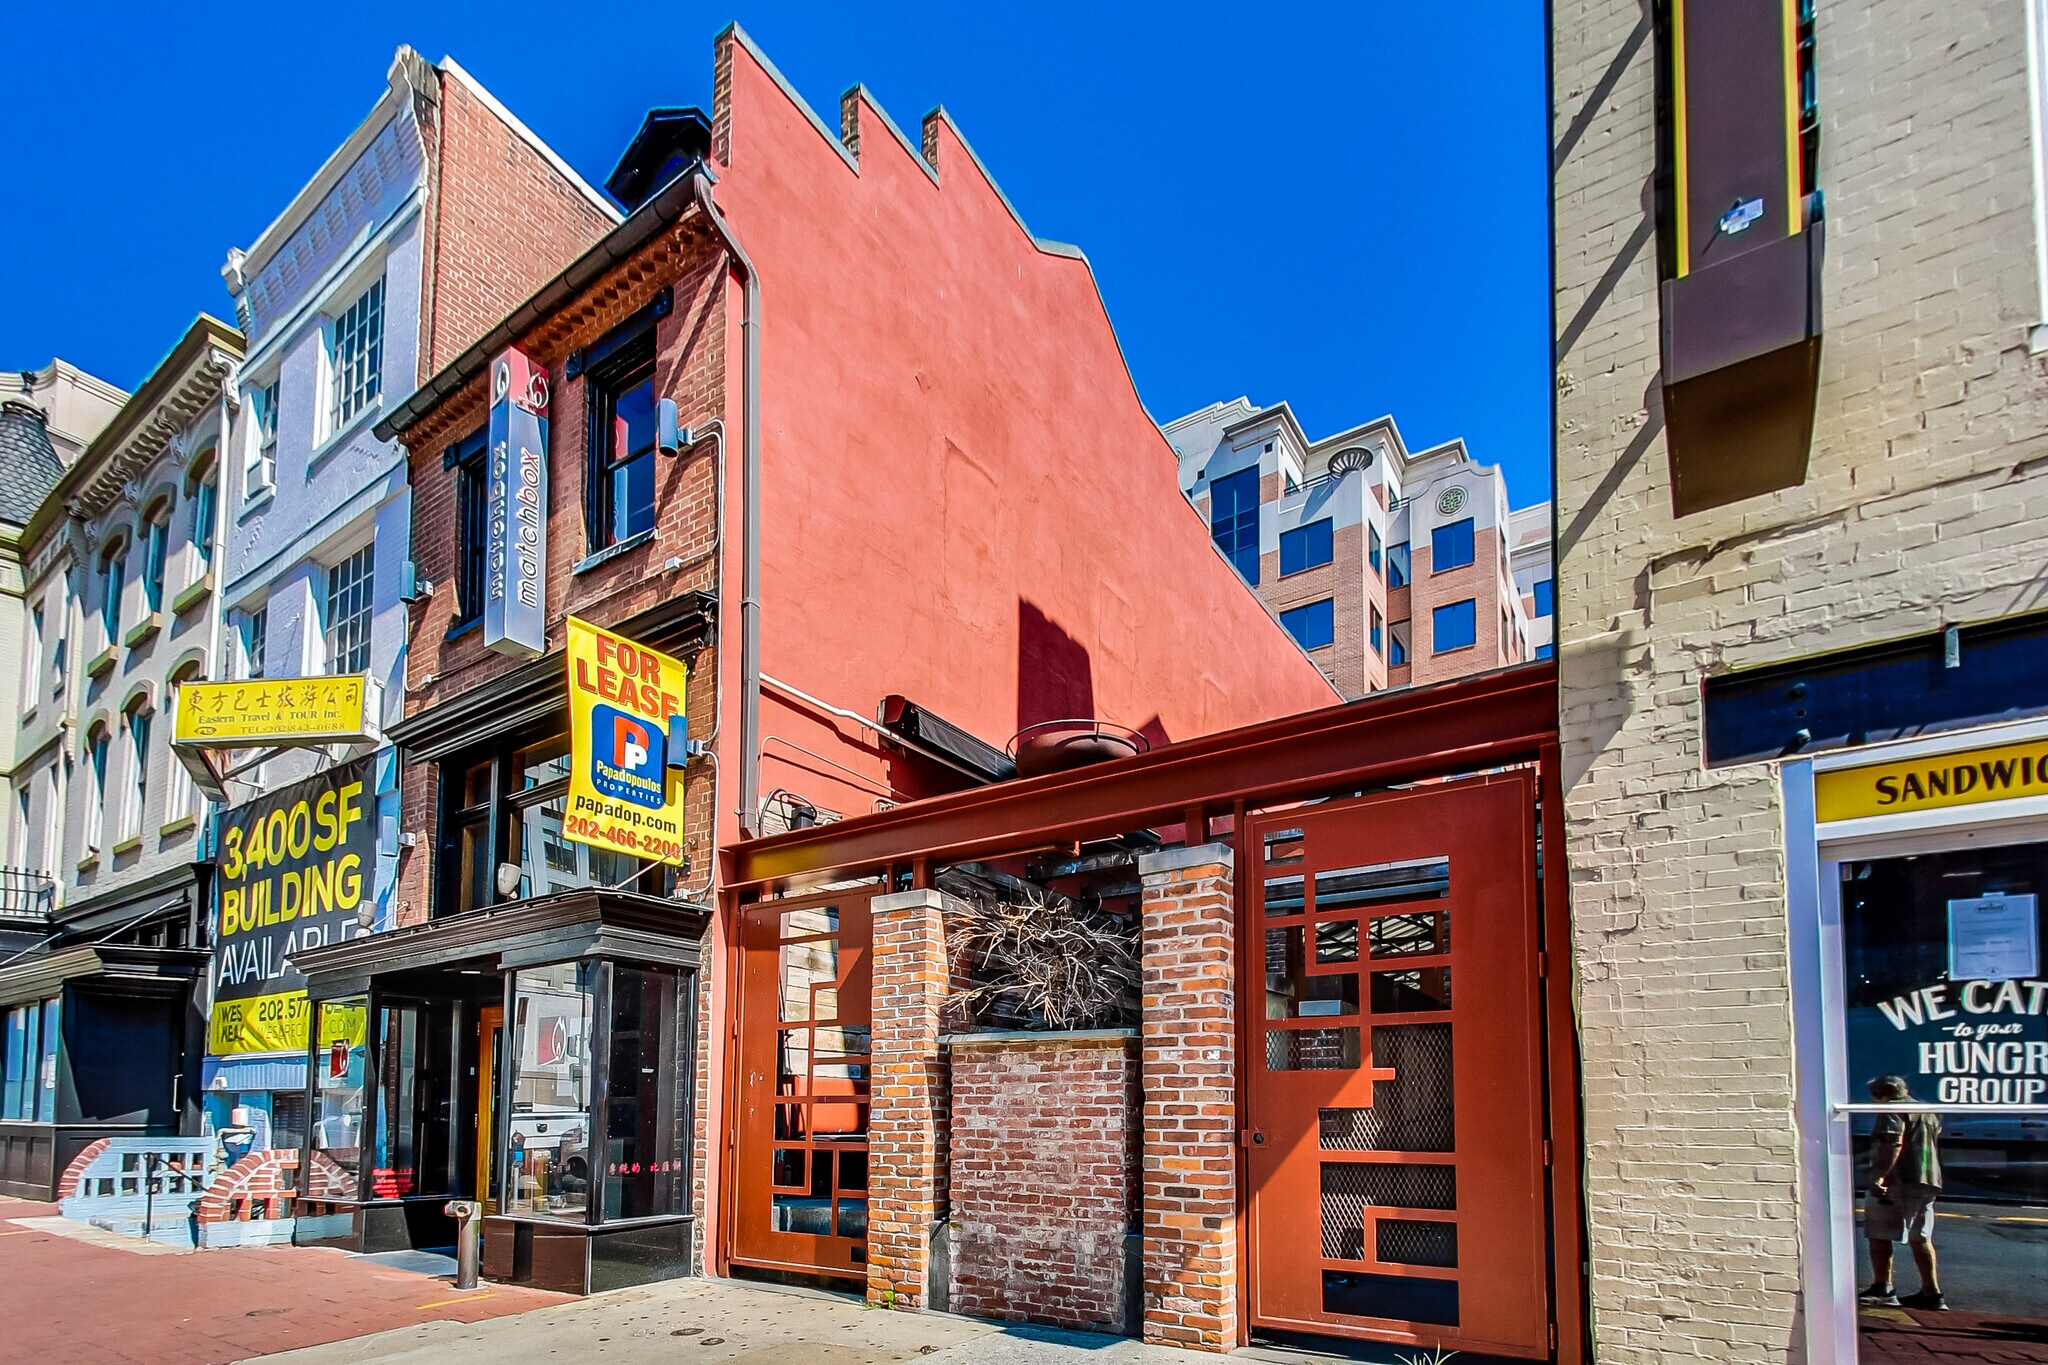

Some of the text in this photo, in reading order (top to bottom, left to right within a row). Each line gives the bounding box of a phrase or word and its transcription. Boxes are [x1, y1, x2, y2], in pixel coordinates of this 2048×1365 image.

[491, 441, 507, 601] matchbox
[516, 447, 541, 608] matchbox
[597, 633, 660, 687] FOR
[577, 658, 678, 722] LEASE
[199, 716, 235, 724] Eastern
[241, 712, 270, 722] Travel
[290, 711, 318, 720] TOUR
[324, 710, 341, 718] Inc.
[597, 760, 662, 794] Papadopoulos
[597, 779, 662, 805] PROPERTIES
[224, 781, 363, 882] 3,400 SF
[576, 794, 677, 834] papadop.com
[566, 815, 682, 860] 202-466-2200
[223, 854, 362, 937] BUILDING
[221, 1004, 243, 1024] WES
[1877, 983, 1958, 1032] WE
[1953, 1022, 2023, 1041] to your
[1918, 1040, 2048, 1076] HUNGR
[1938, 1076, 2046, 1104] GROUP
